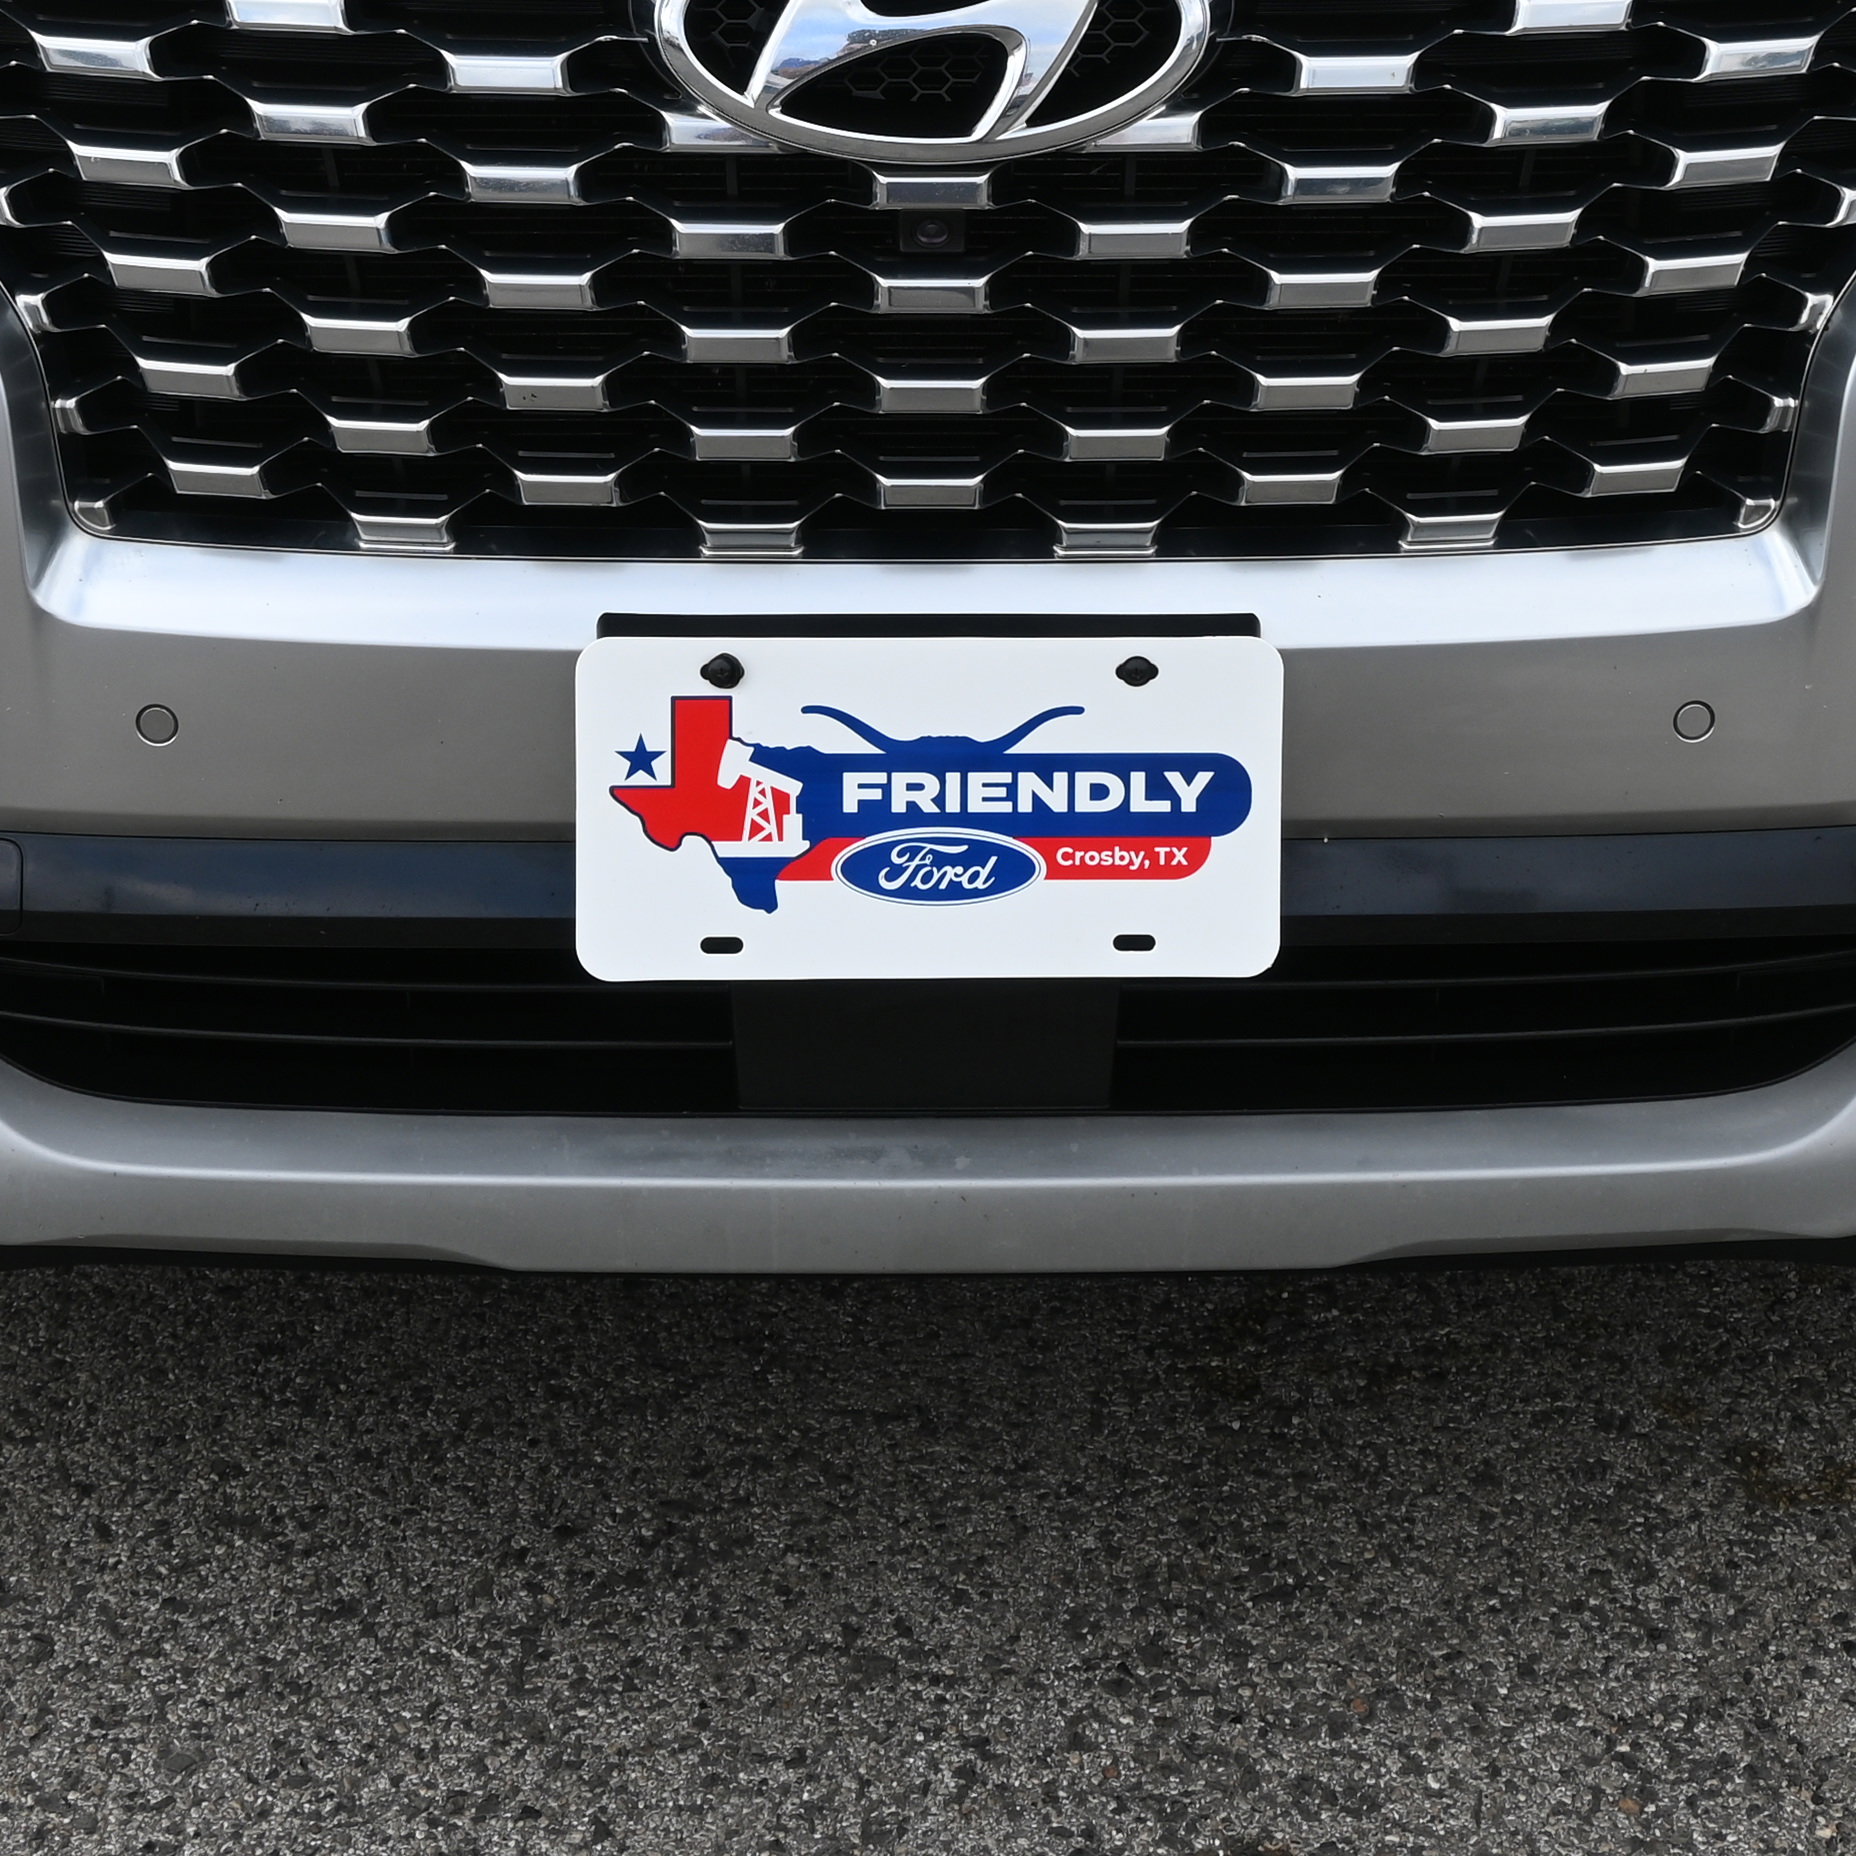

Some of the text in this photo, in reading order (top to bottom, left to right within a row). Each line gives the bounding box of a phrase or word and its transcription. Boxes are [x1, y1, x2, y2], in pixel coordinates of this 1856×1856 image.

[842, 771, 1215, 814] FRIENDLY
[877, 842, 999, 891] Ford
[1055, 846, 1189, 870] Crosby, TX
